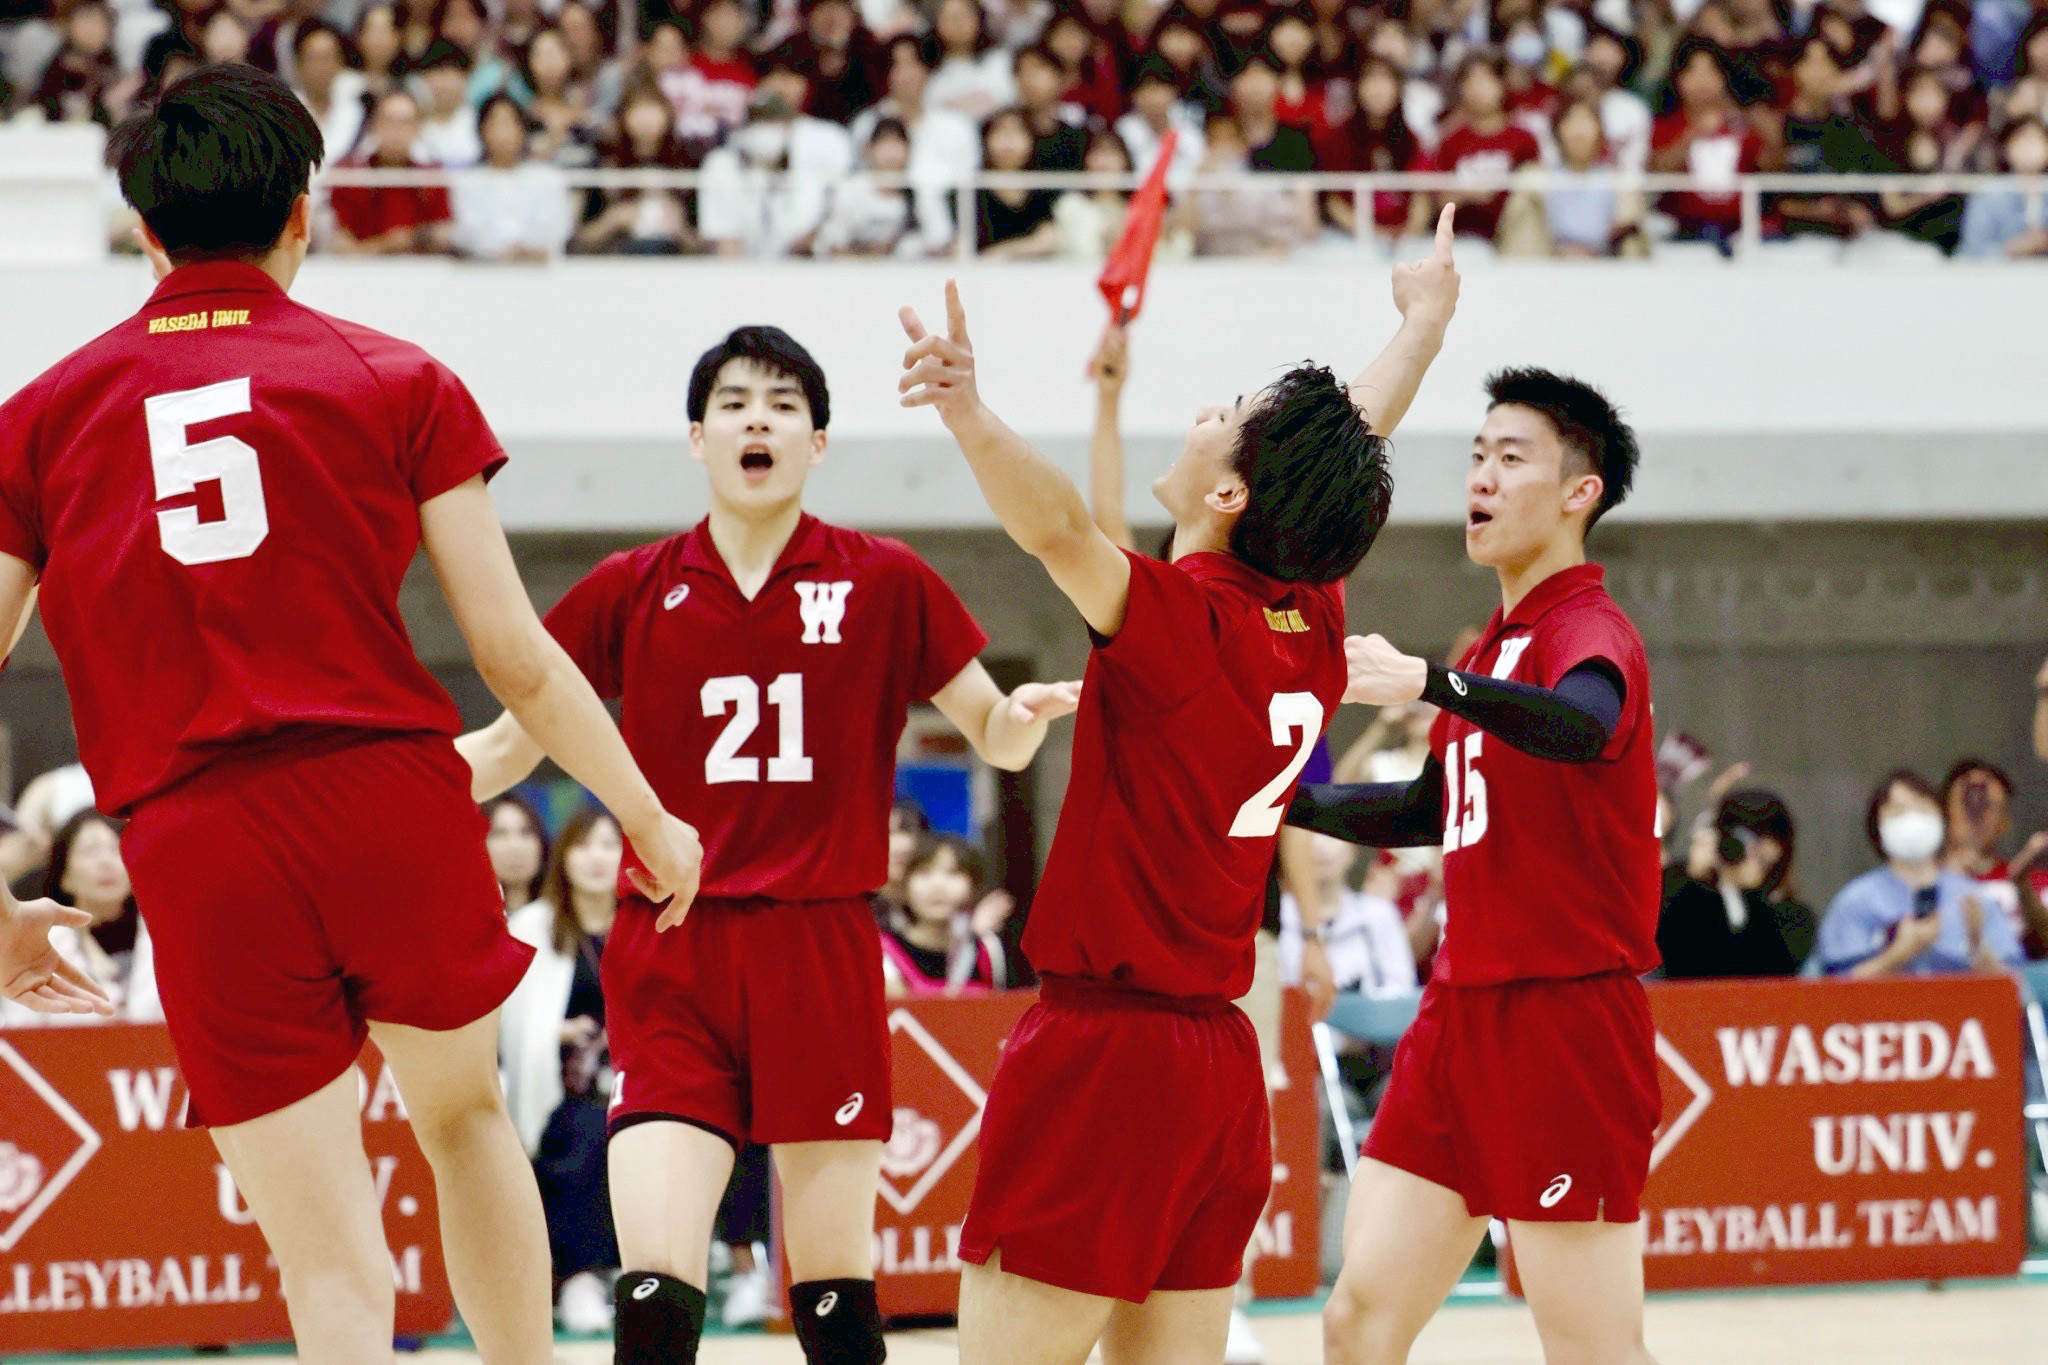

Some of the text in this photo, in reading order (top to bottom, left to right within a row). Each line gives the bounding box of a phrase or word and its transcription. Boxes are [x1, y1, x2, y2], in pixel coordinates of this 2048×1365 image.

[144, 376, 269, 566] 5
[794, 580, 854, 644] W
[700, 672, 814, 785] 21
[1227, 691, 1324, 838] 2
[1442, 731, 1489, 855] 15
[1716, 1018, 1996, 1087] WASEDA
[1812, 1110, 1997, 1176] UNIV.
[1858, 1196, 1999, 1248] TEAM
[0, 1254, 262, 1314] LEYBALL
